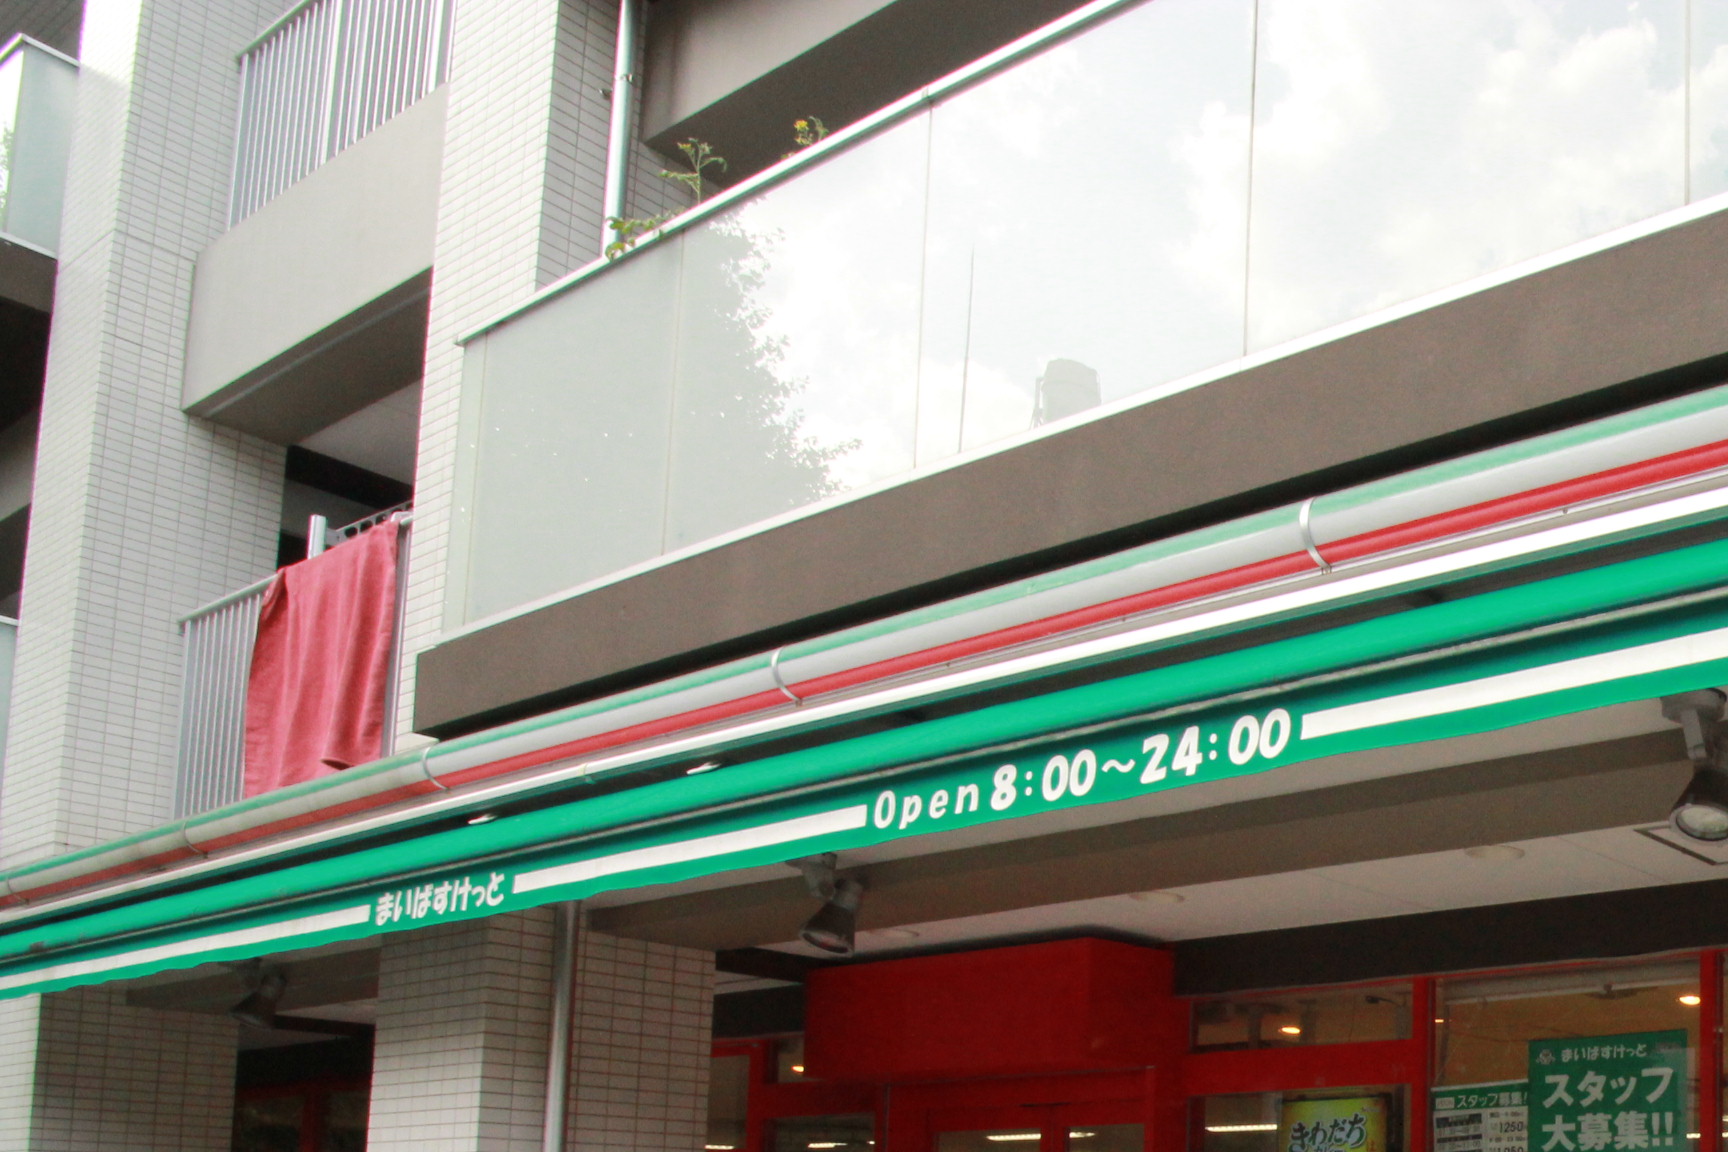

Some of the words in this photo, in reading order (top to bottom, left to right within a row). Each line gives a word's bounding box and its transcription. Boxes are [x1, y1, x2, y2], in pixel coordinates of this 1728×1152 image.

[873, 784, 979, 829] Open
[374, 872, 506, 926] まいばすけっと
[1561, 1043, 1648, 1063] まいばすけっと
[1542, 1067, 1674, 1108] スタッフ
